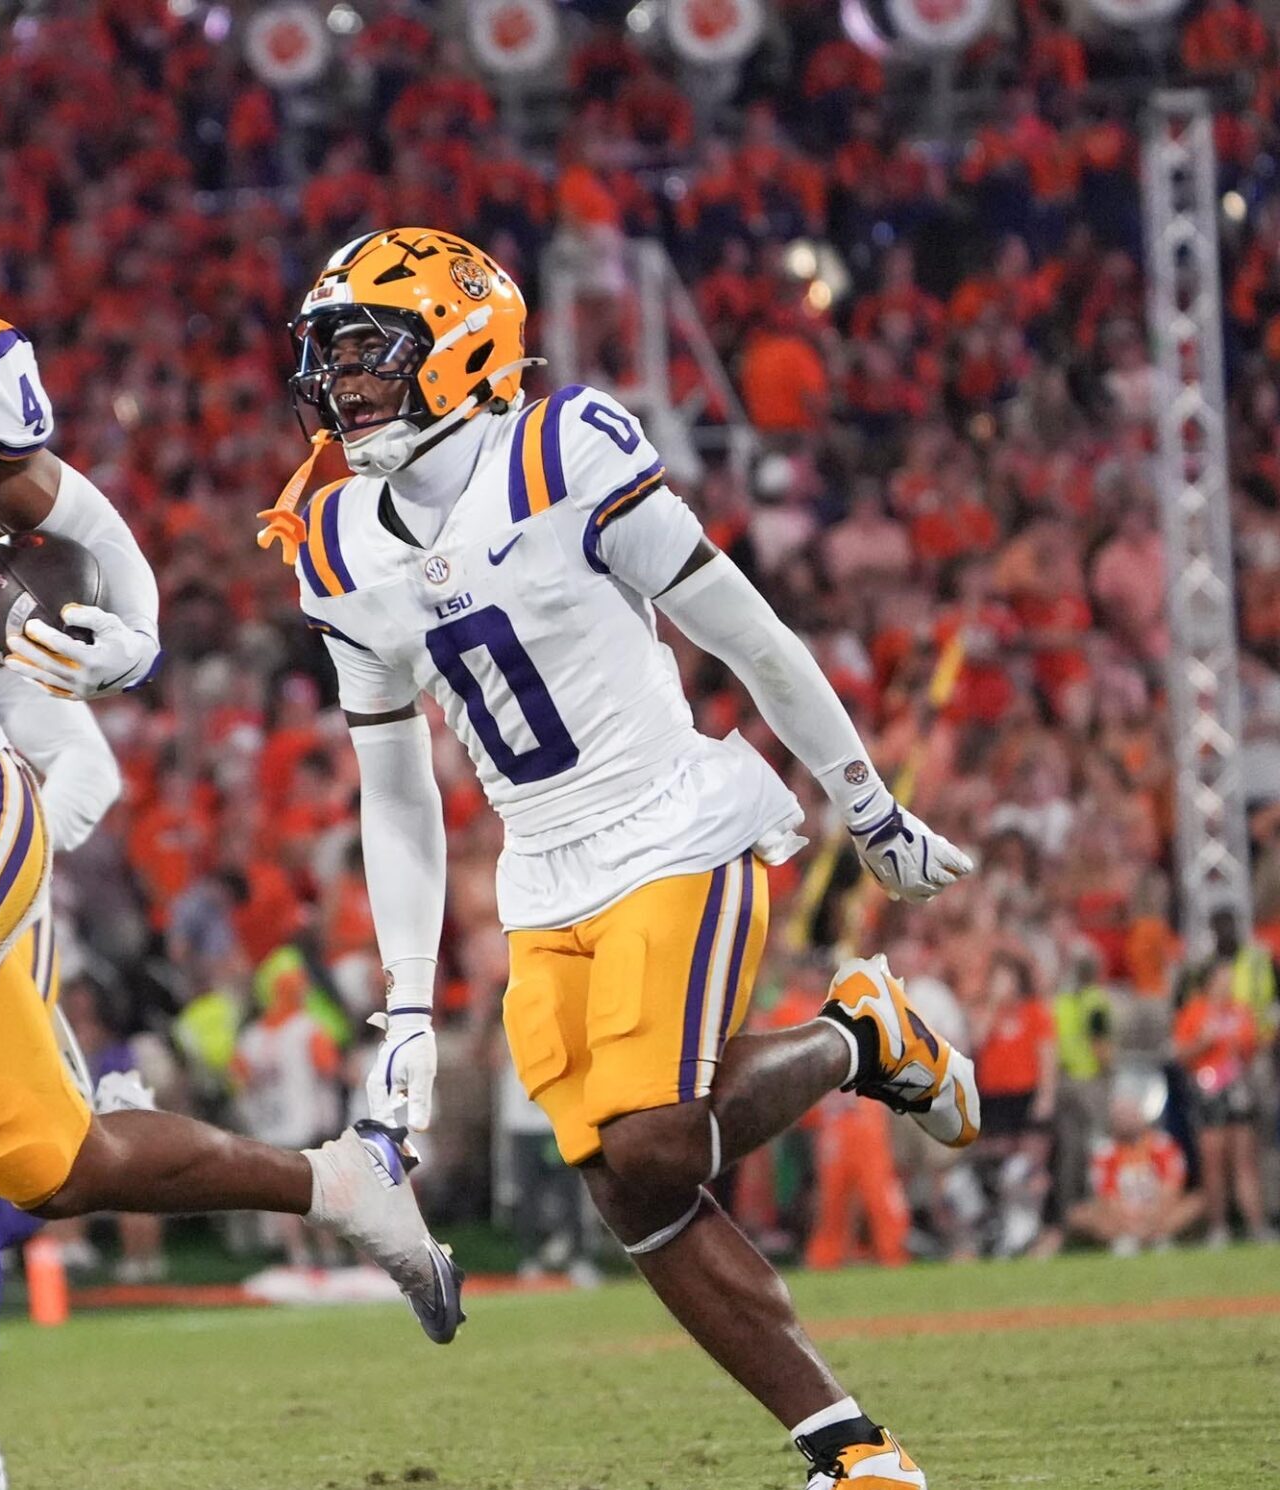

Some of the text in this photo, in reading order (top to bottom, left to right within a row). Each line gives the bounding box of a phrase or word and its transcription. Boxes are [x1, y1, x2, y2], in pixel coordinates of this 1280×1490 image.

[19, 373, 45, 437] 4
[581, 401, 641, 455] 0
[435, 592, 473, 619] LSU
[425, 604, 580, 786] 0
